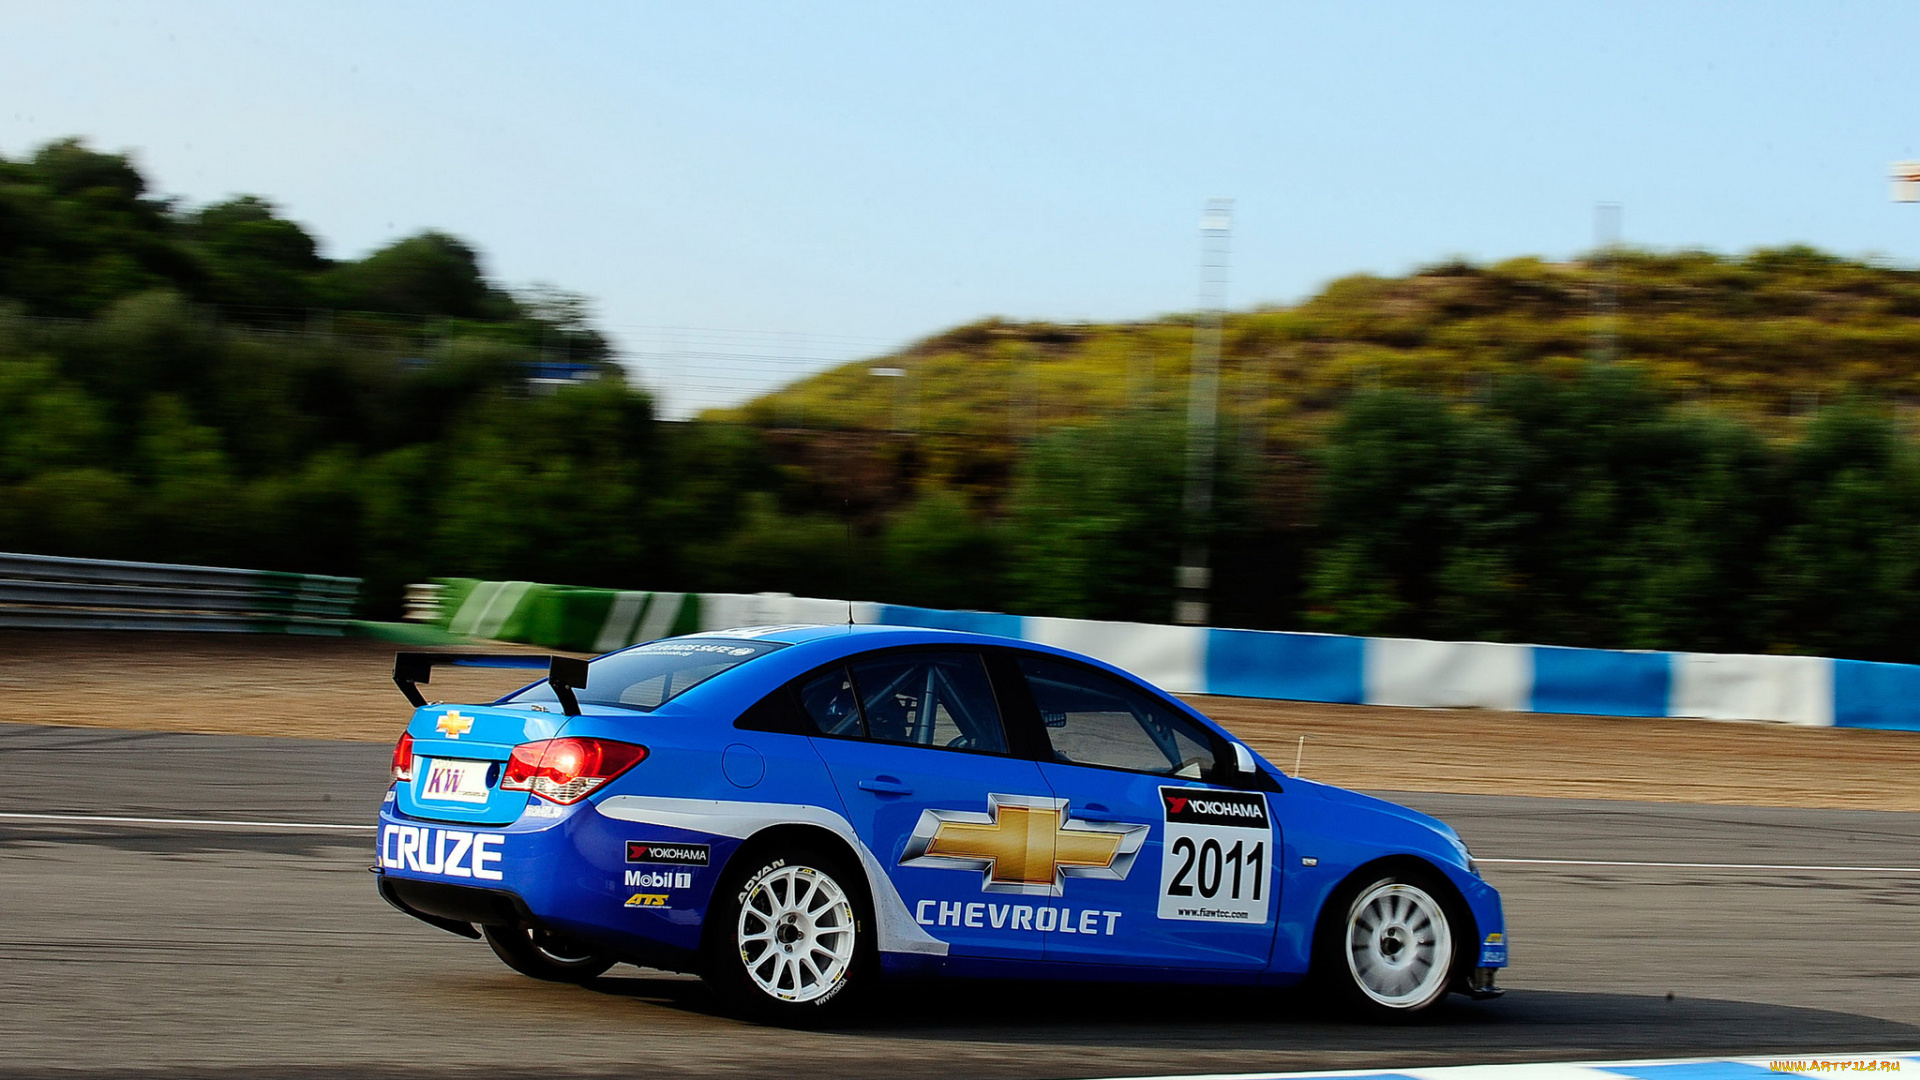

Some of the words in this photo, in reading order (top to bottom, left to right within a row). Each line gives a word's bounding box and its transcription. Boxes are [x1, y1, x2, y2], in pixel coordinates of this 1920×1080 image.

[428, 768, 465, 793] KW
[1188, 799, 1263, 818] YOKOHAMA
[383, 824, 505, 881] CRUZE
[648, 847, 707, 860] YOKOHAMA
[624, 870, 673, 888] Mobil
[1167, 836, 1264, 901] 2011
[737, 858, 785, 905] ADVAN
[625, 893, 669, 906] ATS
[916, 899, 1122, 935] CHEVROLET
[1178, 907, 1248, 919] www.fiawtcc.com
[814, 978, 848, 1006] YOKOHAMA
